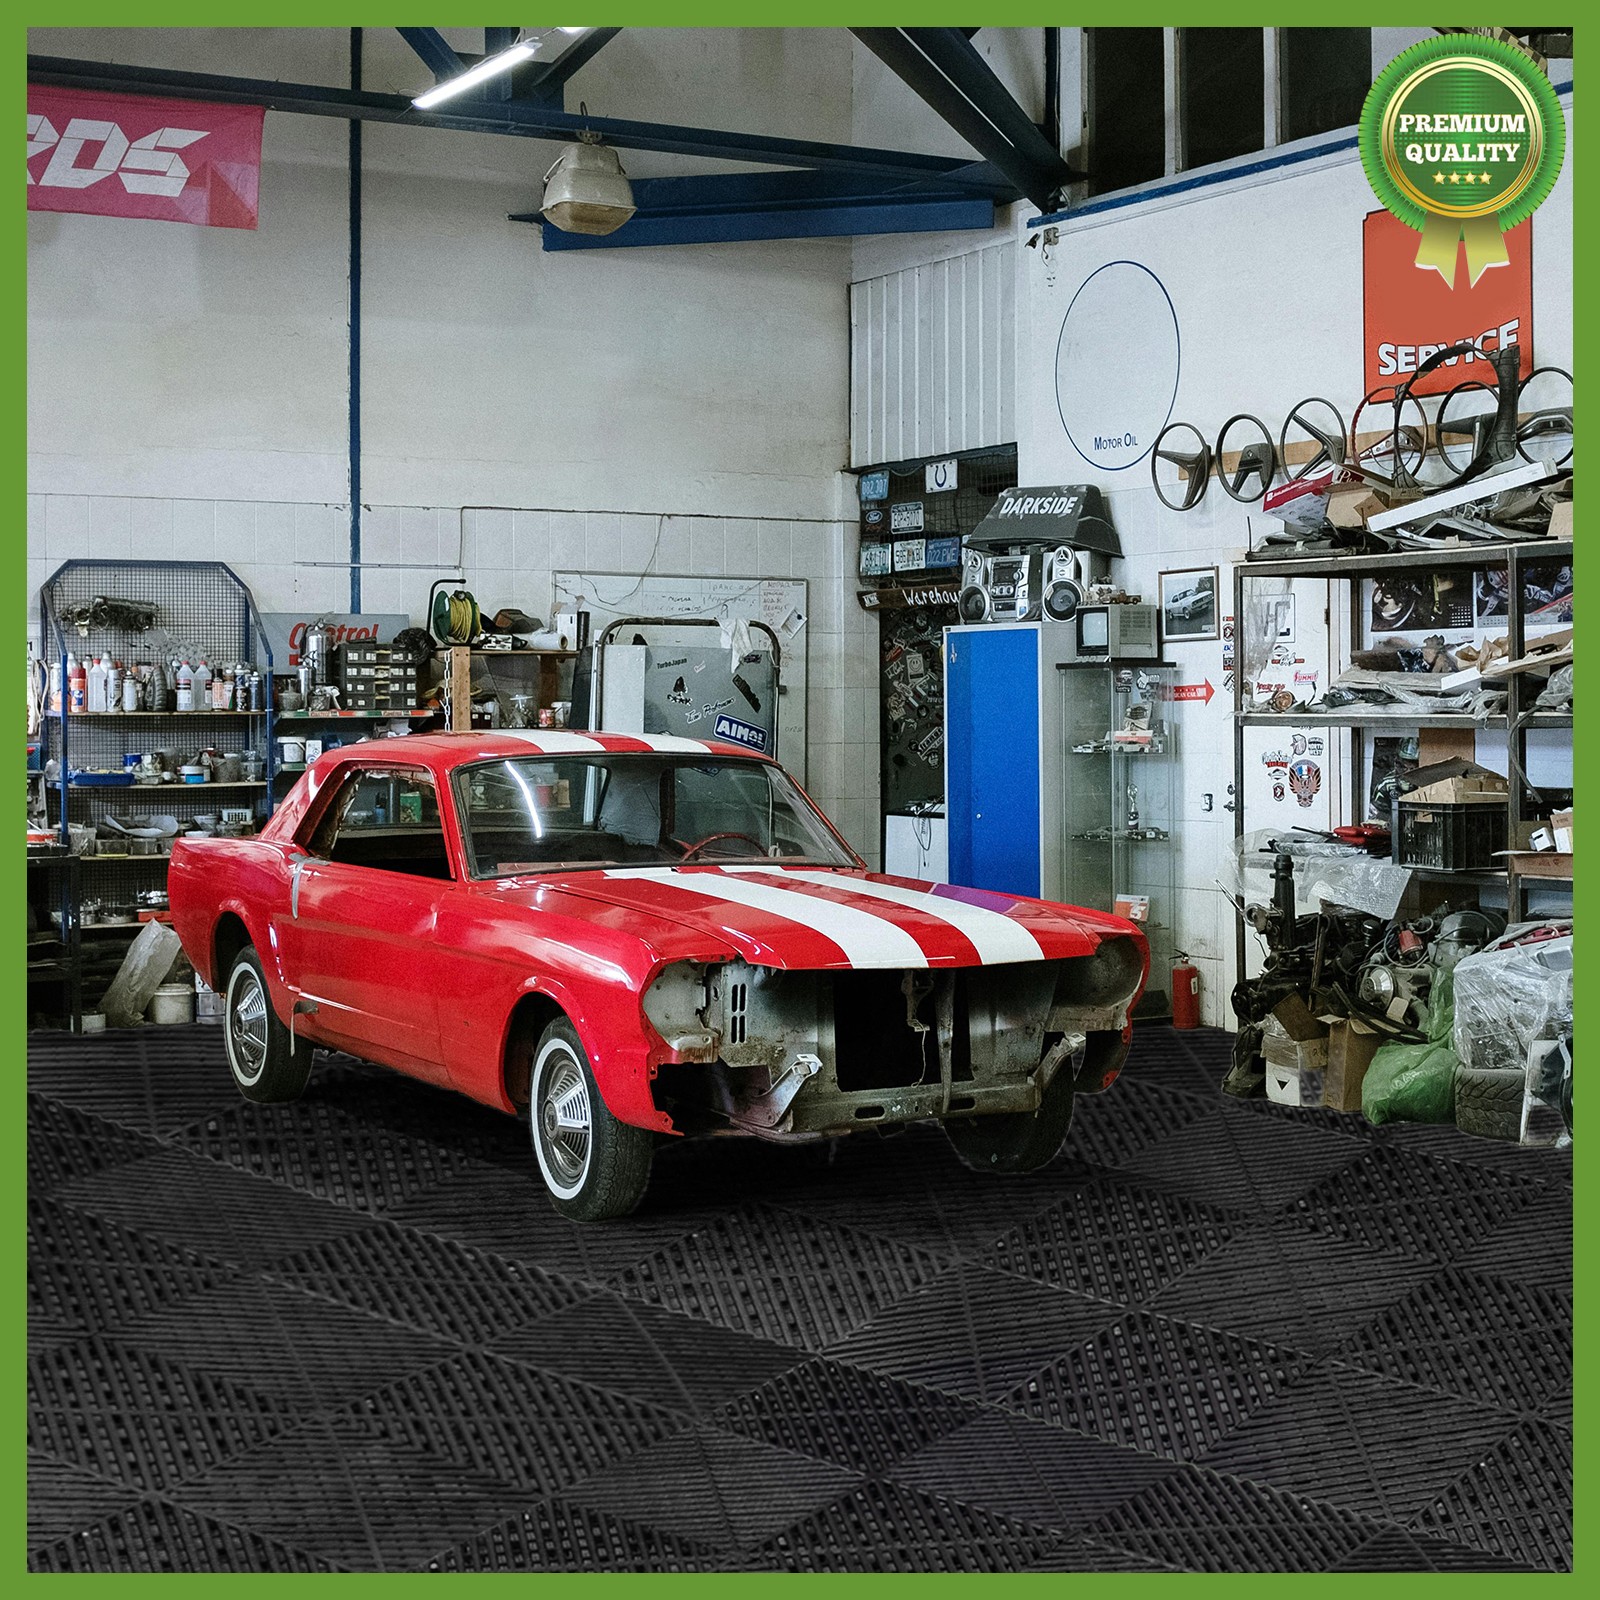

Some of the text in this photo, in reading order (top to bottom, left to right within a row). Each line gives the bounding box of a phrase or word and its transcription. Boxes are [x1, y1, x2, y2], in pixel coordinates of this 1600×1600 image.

[1000, 496, 1078, 514] DARKSIDE
[902, 587, 962, 606] Warehou
[289, 622, 379, 650] Cstrol
